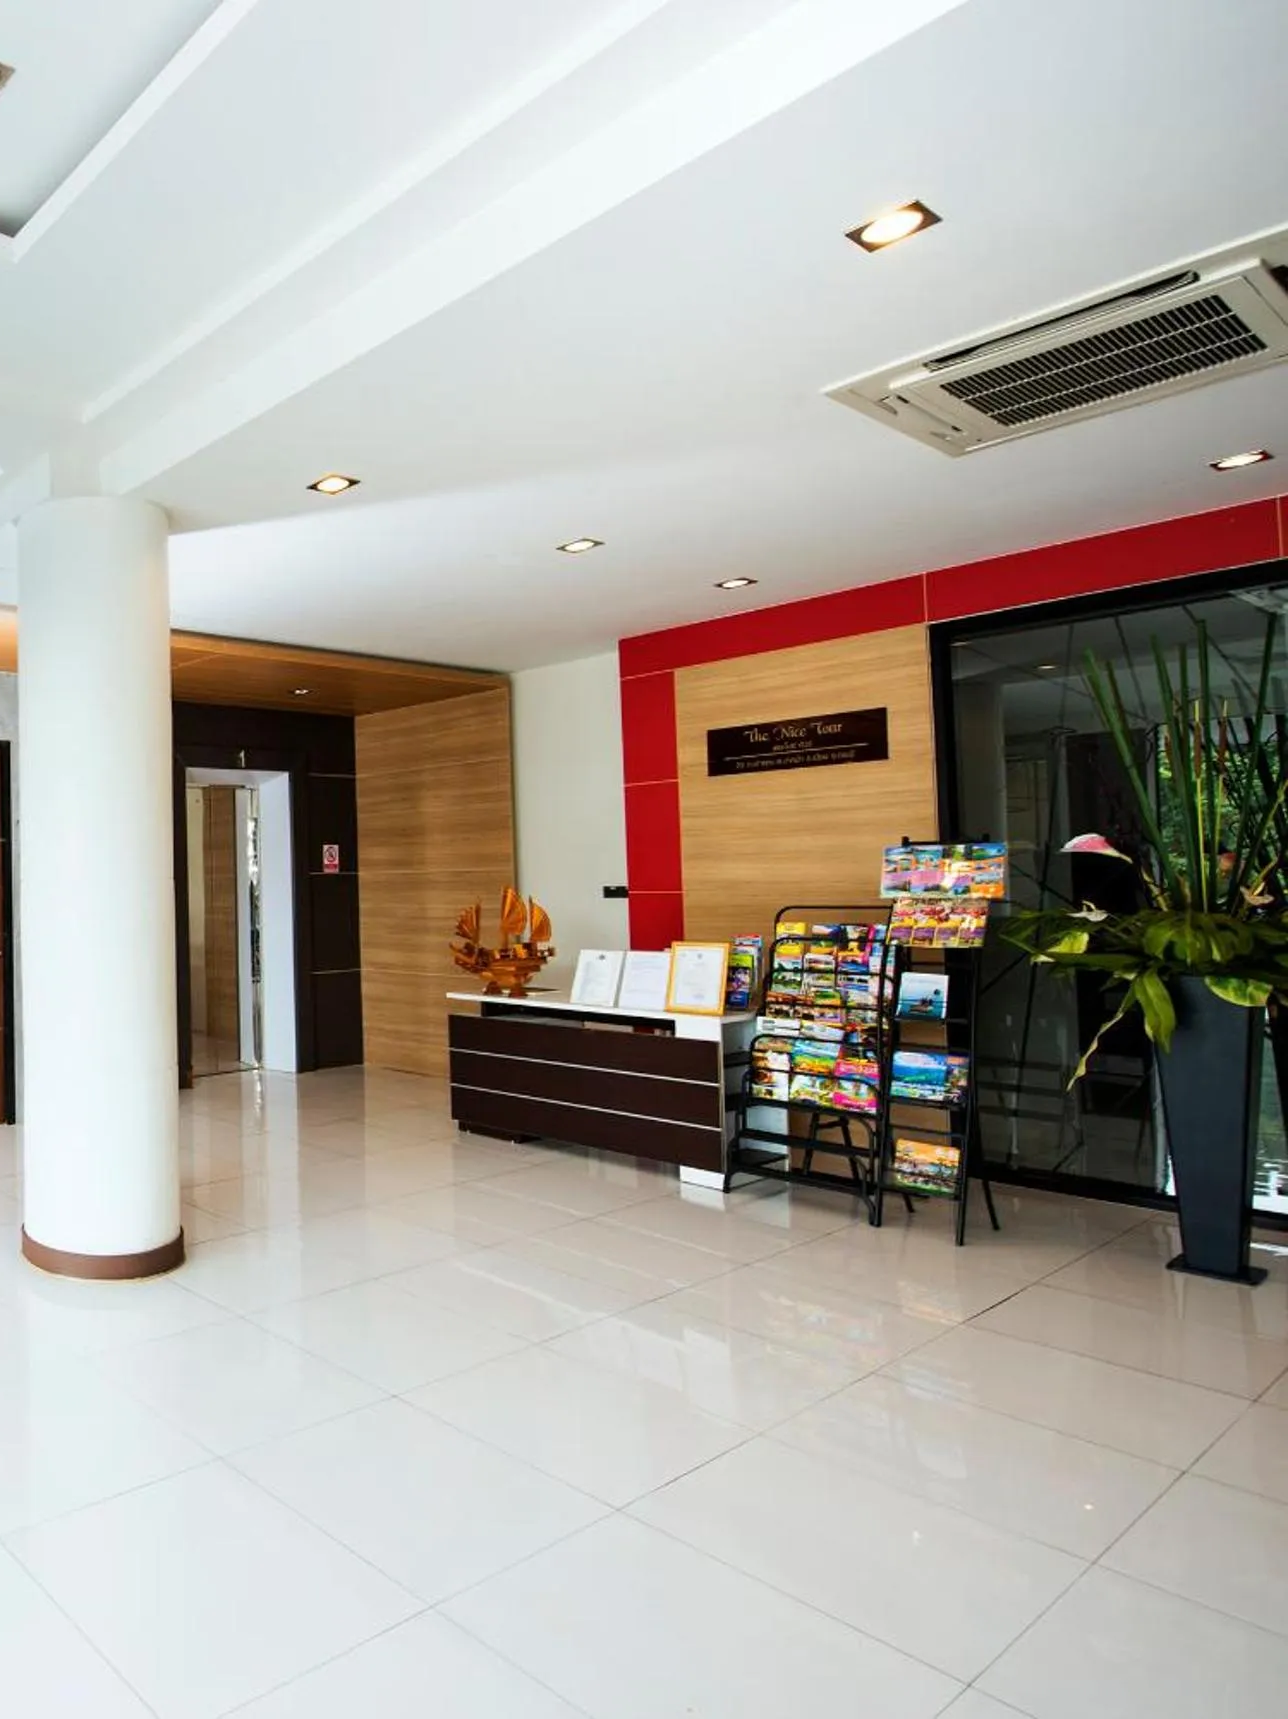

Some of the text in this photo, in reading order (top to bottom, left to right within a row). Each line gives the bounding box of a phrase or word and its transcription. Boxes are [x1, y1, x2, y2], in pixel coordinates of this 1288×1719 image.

[744, 729, 769, 743] The
[773, 725, 807, 741] Nice
[238, 749, 247, 769] 1
